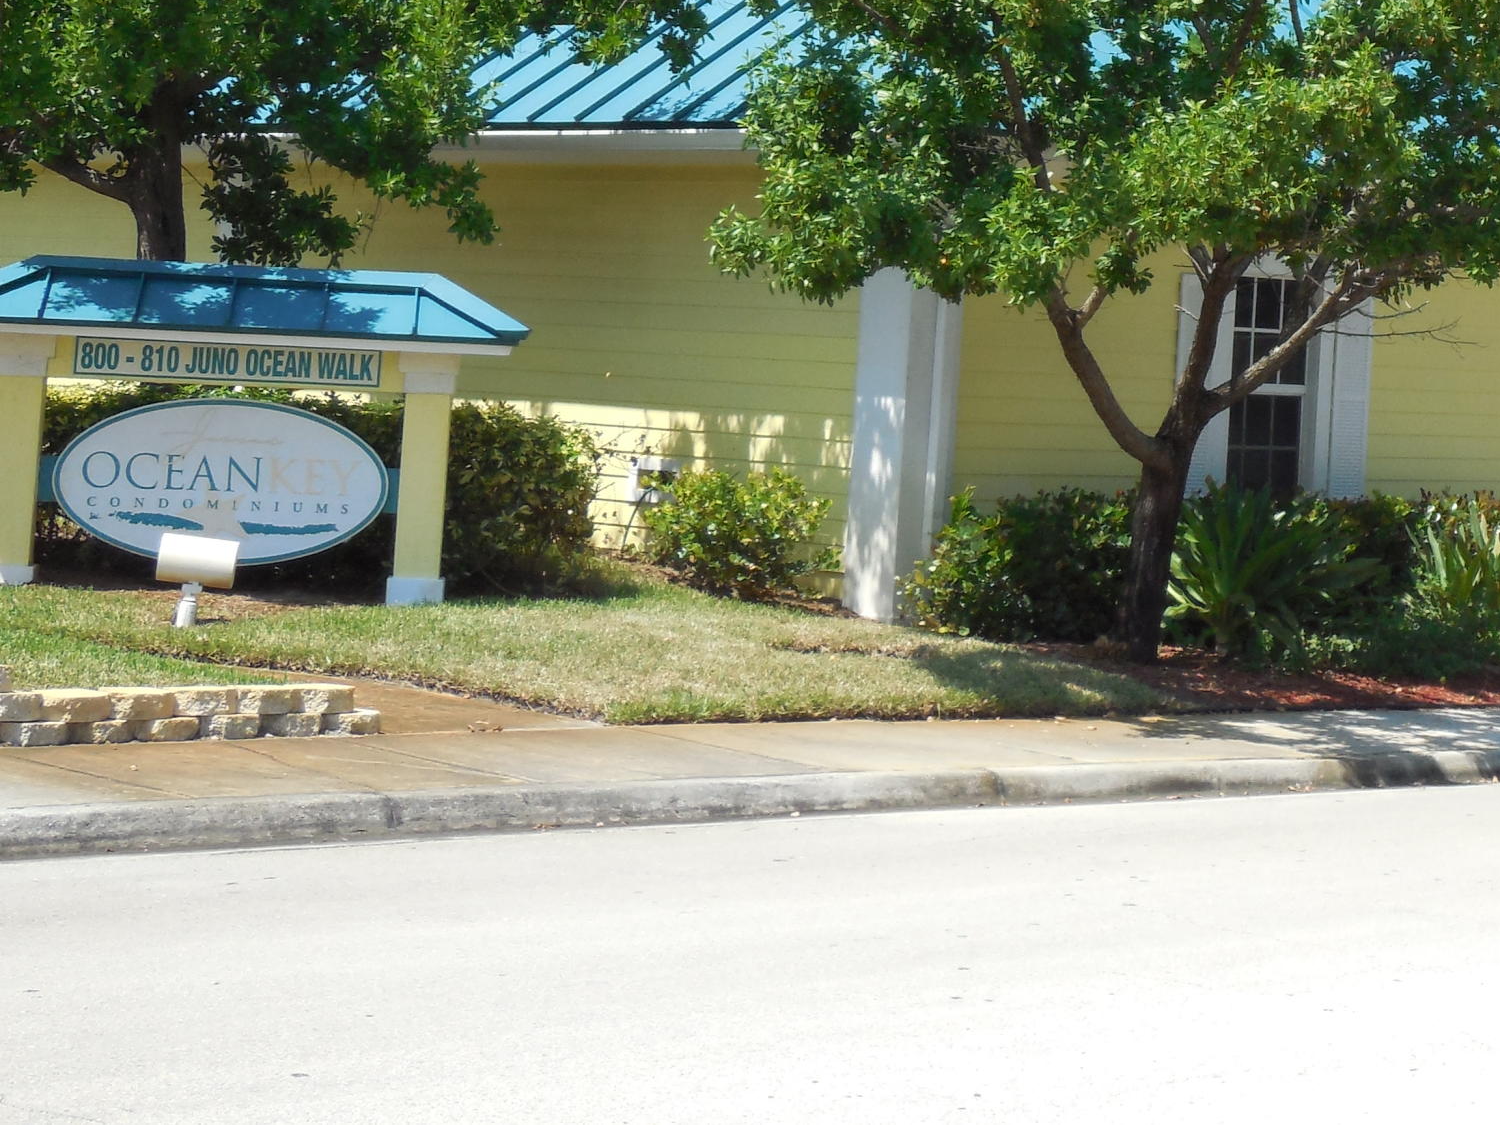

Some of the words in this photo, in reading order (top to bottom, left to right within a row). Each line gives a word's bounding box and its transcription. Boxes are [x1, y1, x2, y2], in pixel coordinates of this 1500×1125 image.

[80, 342, 119, 370] 800
[141, 345, 179, 373] 810
[185, 347, 238, 375] JUNO
[245, 349, 311, 379] OCEAN
[317, 352, 373, 381] WALK
[87, 496, 349, 515] CONDOMINIUMS
